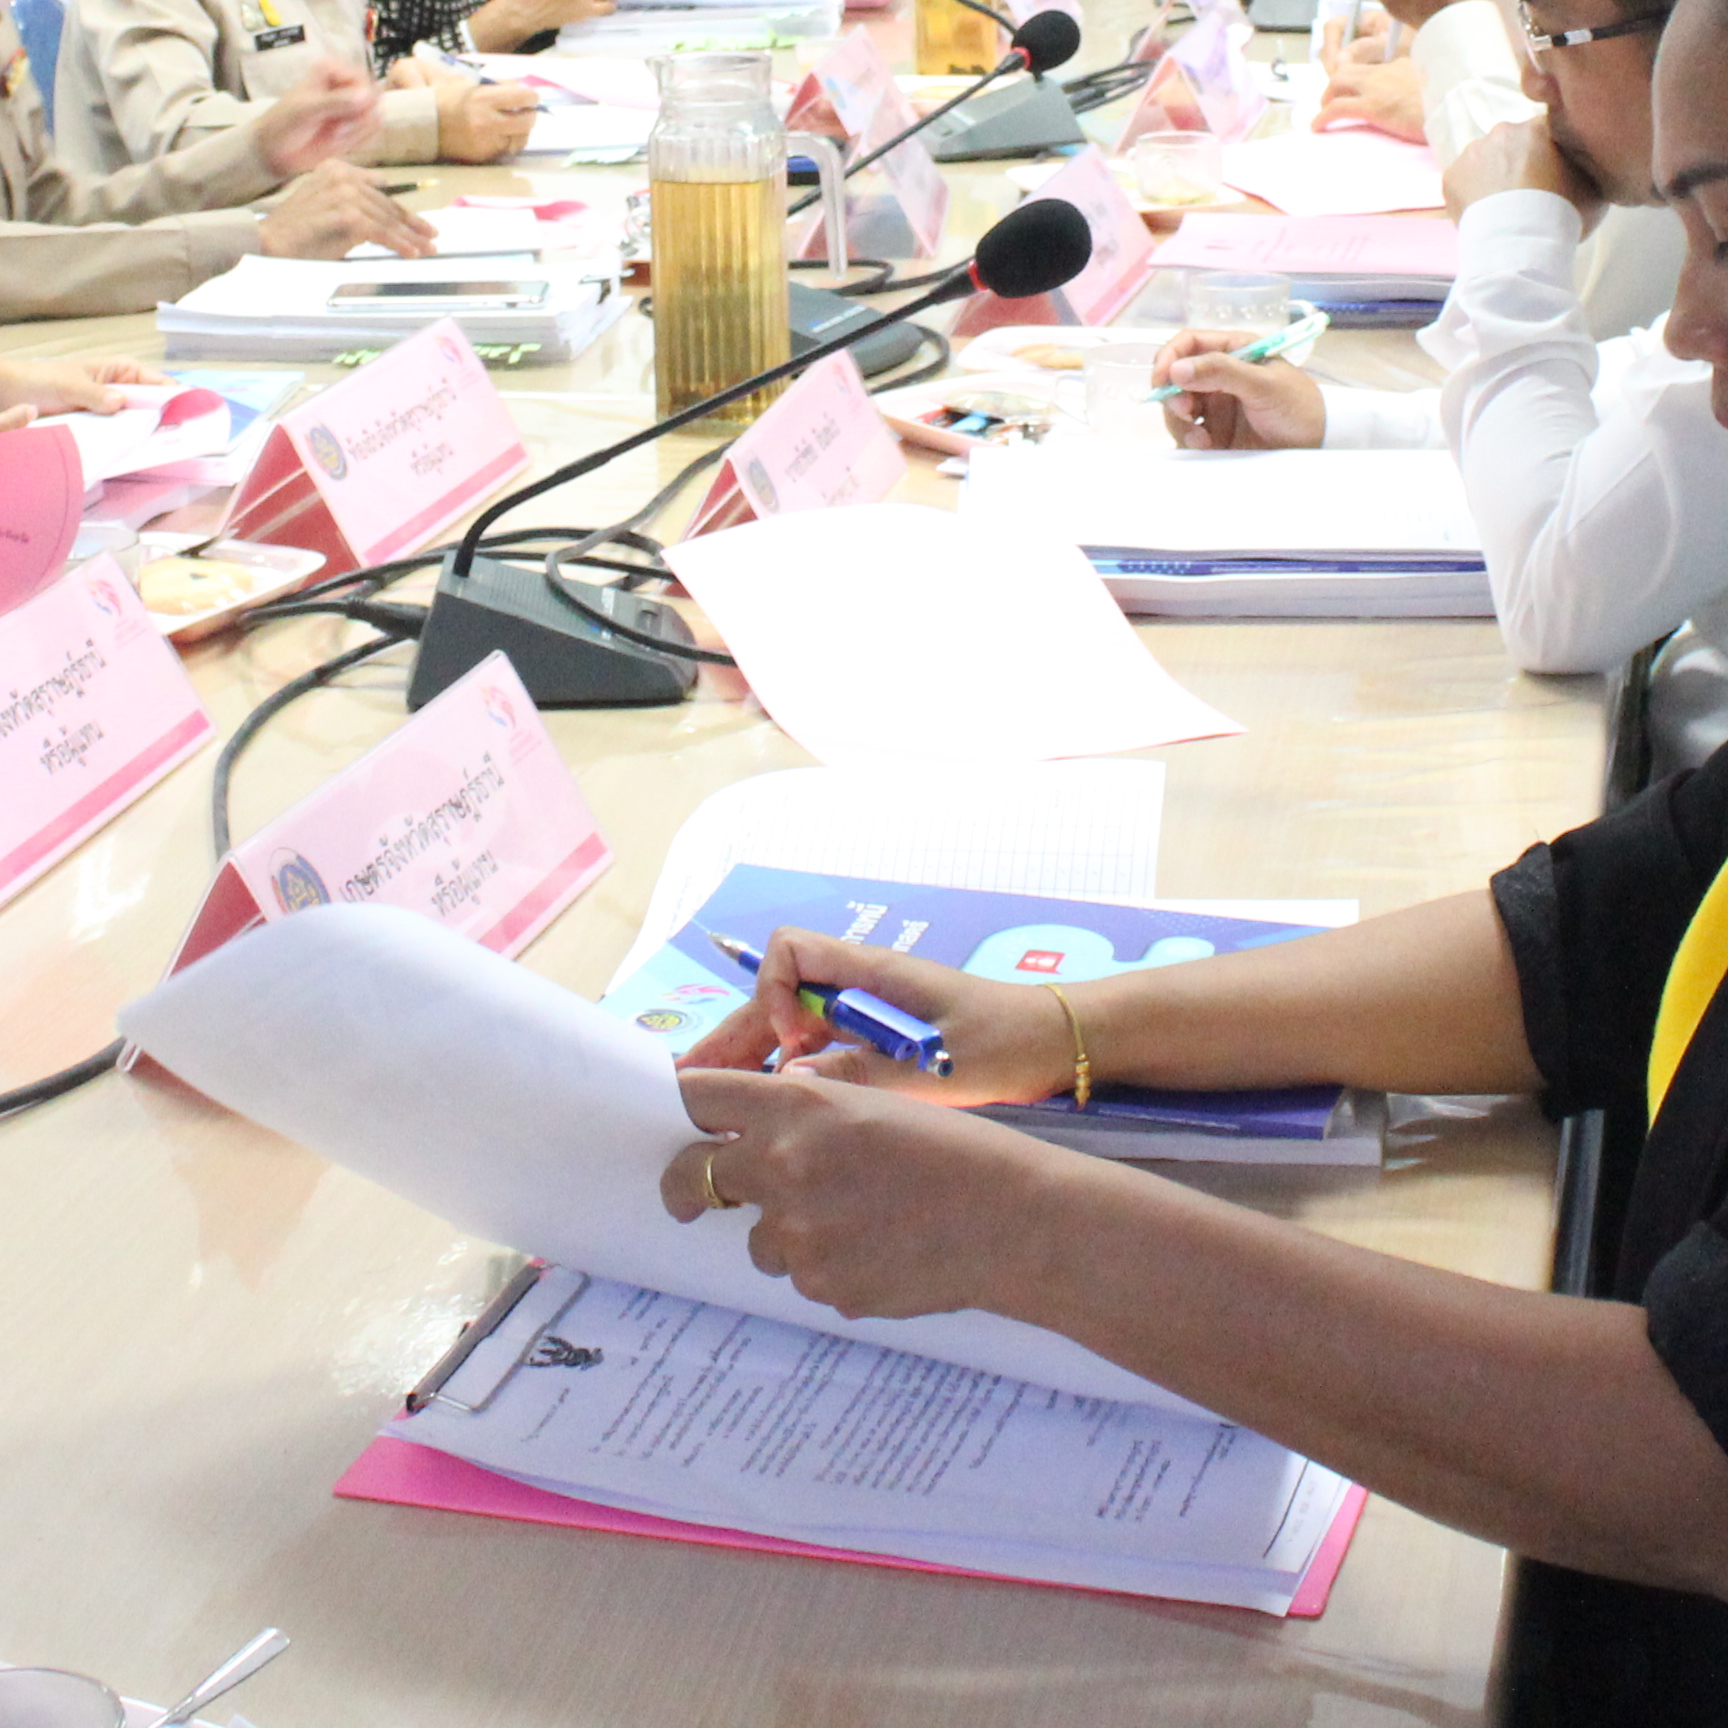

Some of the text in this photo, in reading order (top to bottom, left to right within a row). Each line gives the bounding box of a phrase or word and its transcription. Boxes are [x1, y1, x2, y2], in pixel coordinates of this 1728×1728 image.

[39, 719, 104, 774] หรือผู้แทน
[431, 849, 499, 916] หรือผู้แทน
